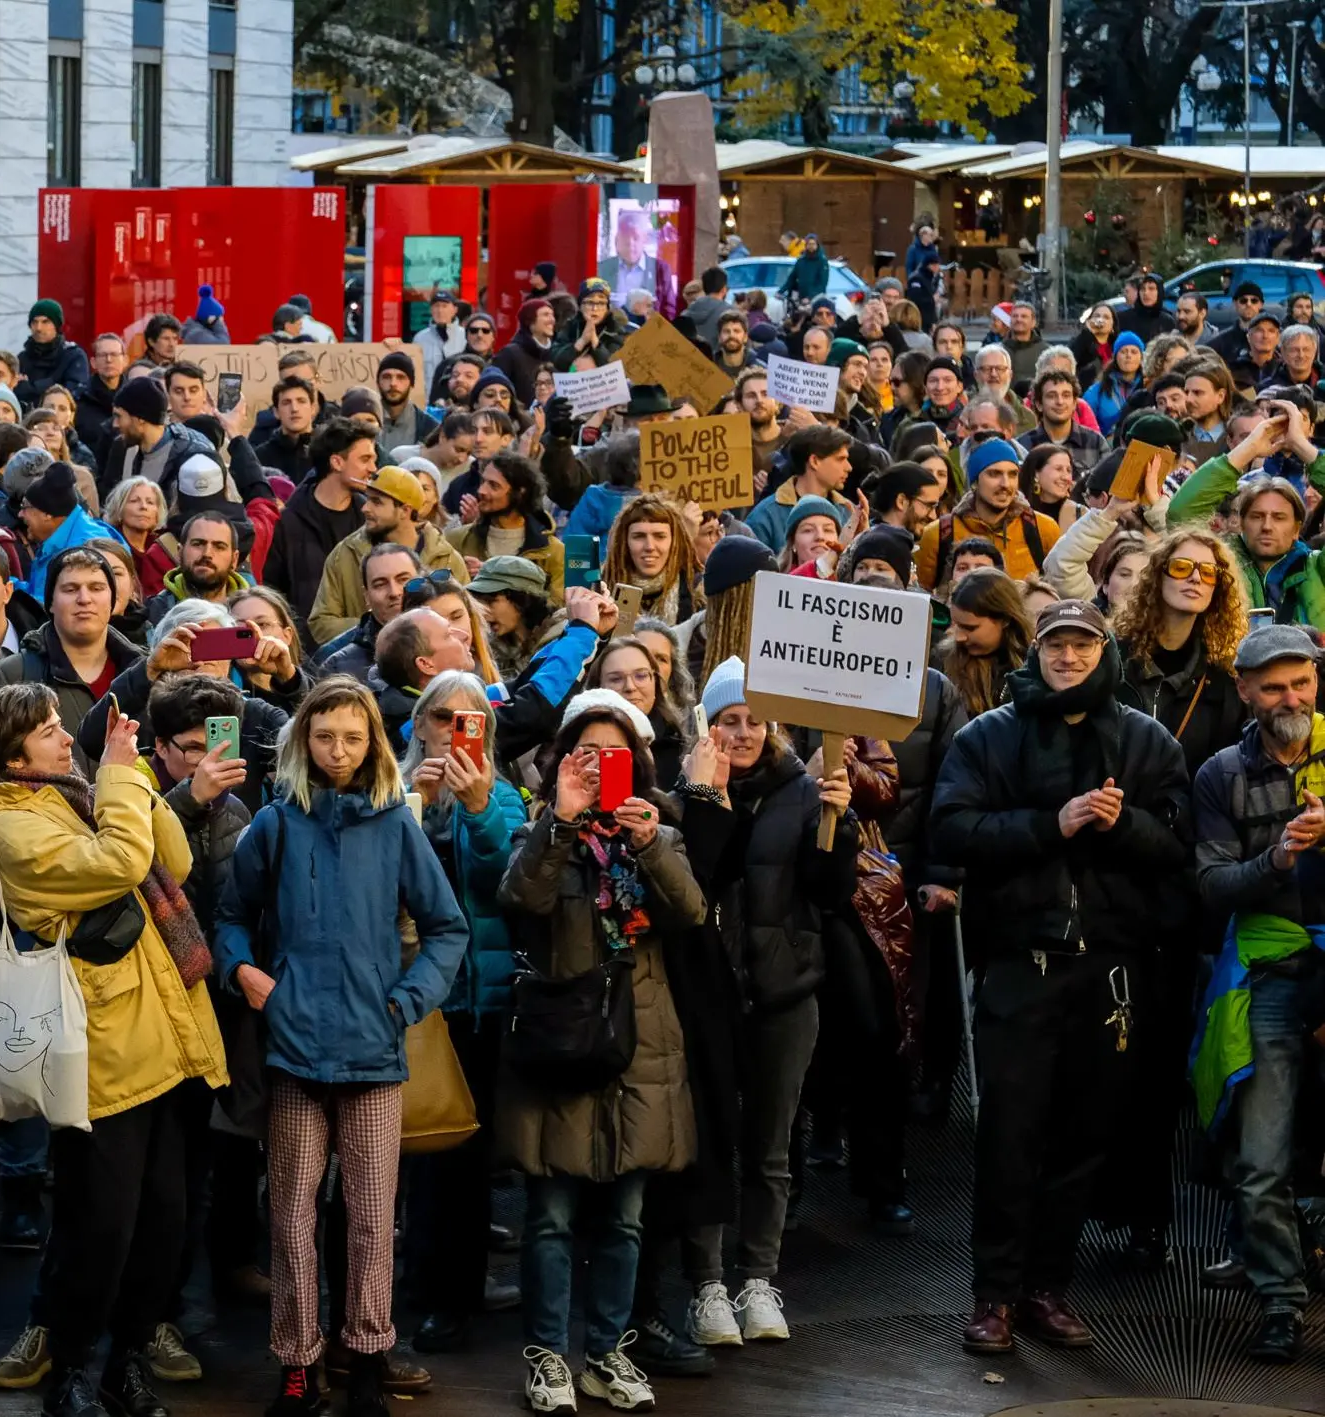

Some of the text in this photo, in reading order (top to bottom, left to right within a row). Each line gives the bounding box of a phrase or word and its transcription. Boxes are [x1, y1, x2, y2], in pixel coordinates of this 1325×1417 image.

[317, 347, 381, 384] CHRiST
[777, 363, 827, 379] ABER WEHE
[774, 380, 827, 398] ICH AUF DAS
[802, 379, 829, 389] WENN
[645, 460, 677, 481] TO
[777, 589, 903, 625] IL FASCISMO
[832, 620, 843, 643] È
[905, 661, 912, 679] !
